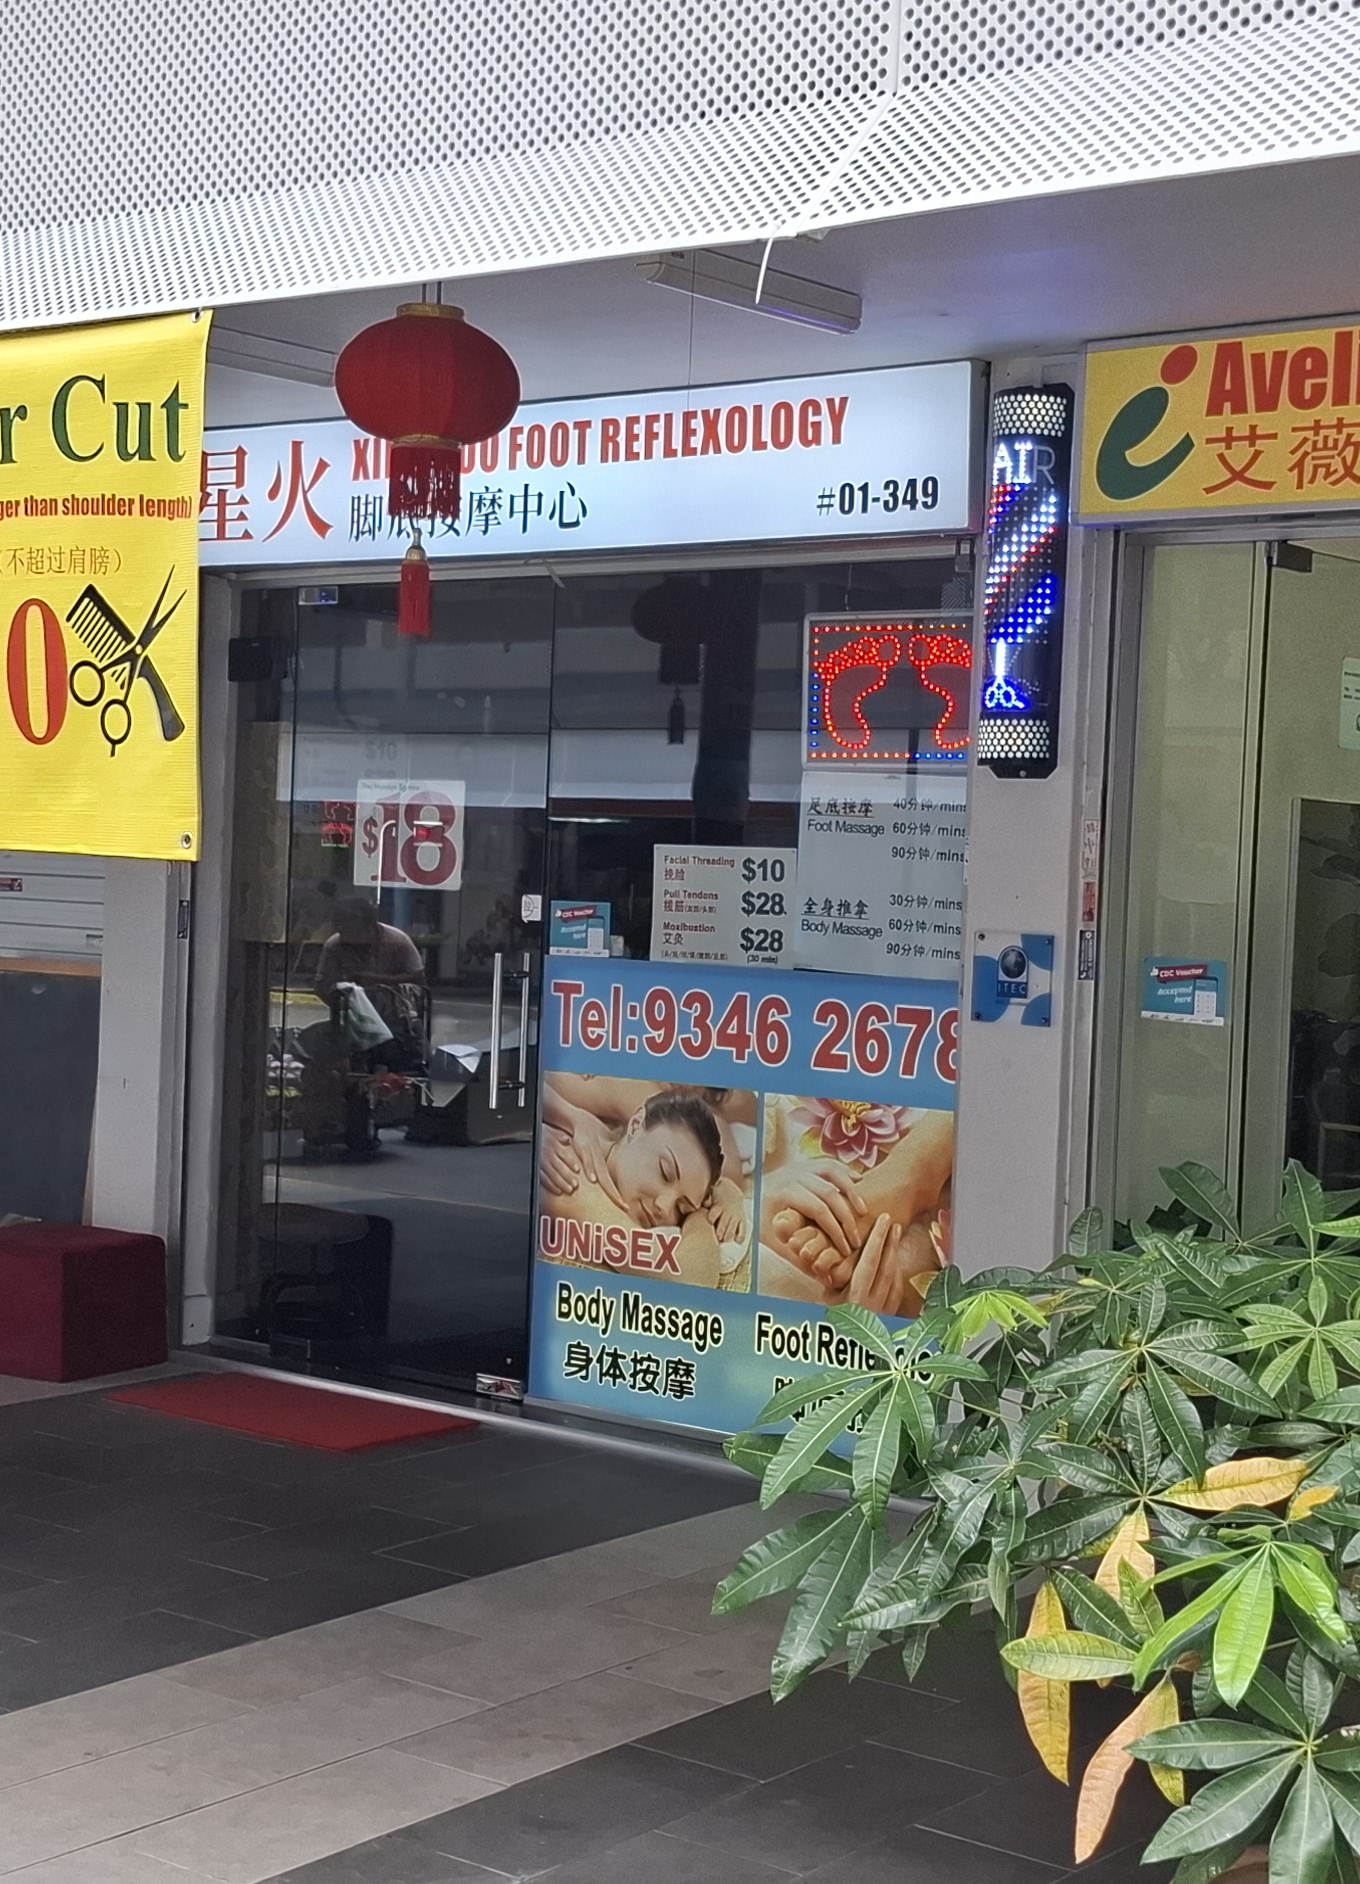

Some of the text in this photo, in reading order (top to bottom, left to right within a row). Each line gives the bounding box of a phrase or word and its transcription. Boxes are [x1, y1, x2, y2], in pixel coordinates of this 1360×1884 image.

[51, 374, 189, 463] Cut
[508, 420, 593, 470] FOOT
[600, 396, 850, 465] REFLEXOLOGY
[24, 495, 58, 517] than
[61, 493, 135, 516] shoulder
[139, 494, 192, 521] length)
[199, 440, 334, 542] 星火
[816, 475, 941, 516] #01-349
[361, 791, 458, 887] $18
[807, 819, 832, 833] Foot
[835, 820, 885, 838] Massage
[664, 855, 785, 884] Facial Threading $10
[664, 889, 680, 899] Pull
[683, 890, 719, 901] Tendons
[663, 922, 783, 954] Moxibustion $28
[801, 919, 829, 936] Body
[832, 922, 883, 940] Massage
[997, 981, 1027, 996] ITEC
[1160, 969, 1175, 978] CDC
[551, 980, 959, 1084] Tel:9346 2678
[540, 1216, 681, 1275] UNiSEX
[557, 1282, 615, 1327] Body
[620, 1293, 723, 1353] Massage
[756, 1313, 811, 1363] Foot
[563, 1340, 697, 1400] 身体按摩
